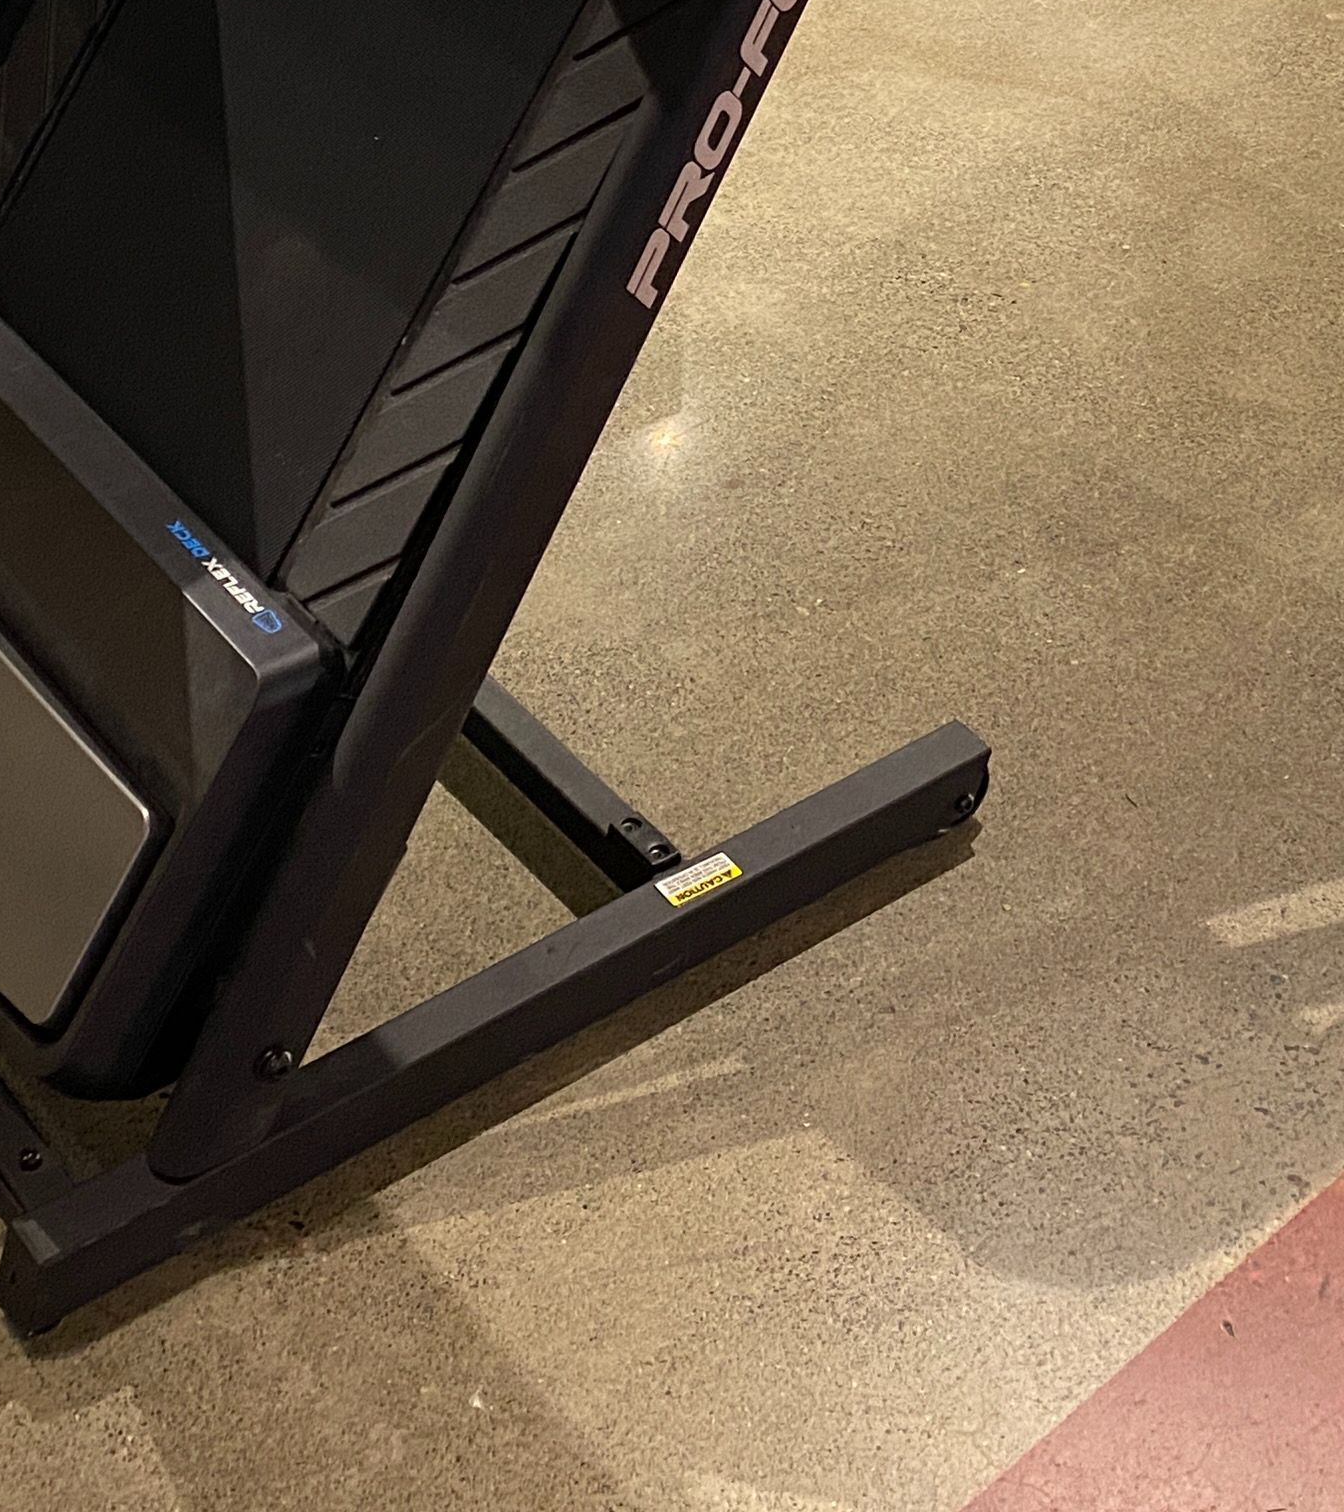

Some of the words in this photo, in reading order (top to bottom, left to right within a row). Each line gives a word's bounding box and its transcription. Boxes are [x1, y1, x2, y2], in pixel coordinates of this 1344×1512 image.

[167, 519, 218, 562] DECK
[200, 557, 263, 615] REFLEX
[676, 873, 724, 902] CAUTION
